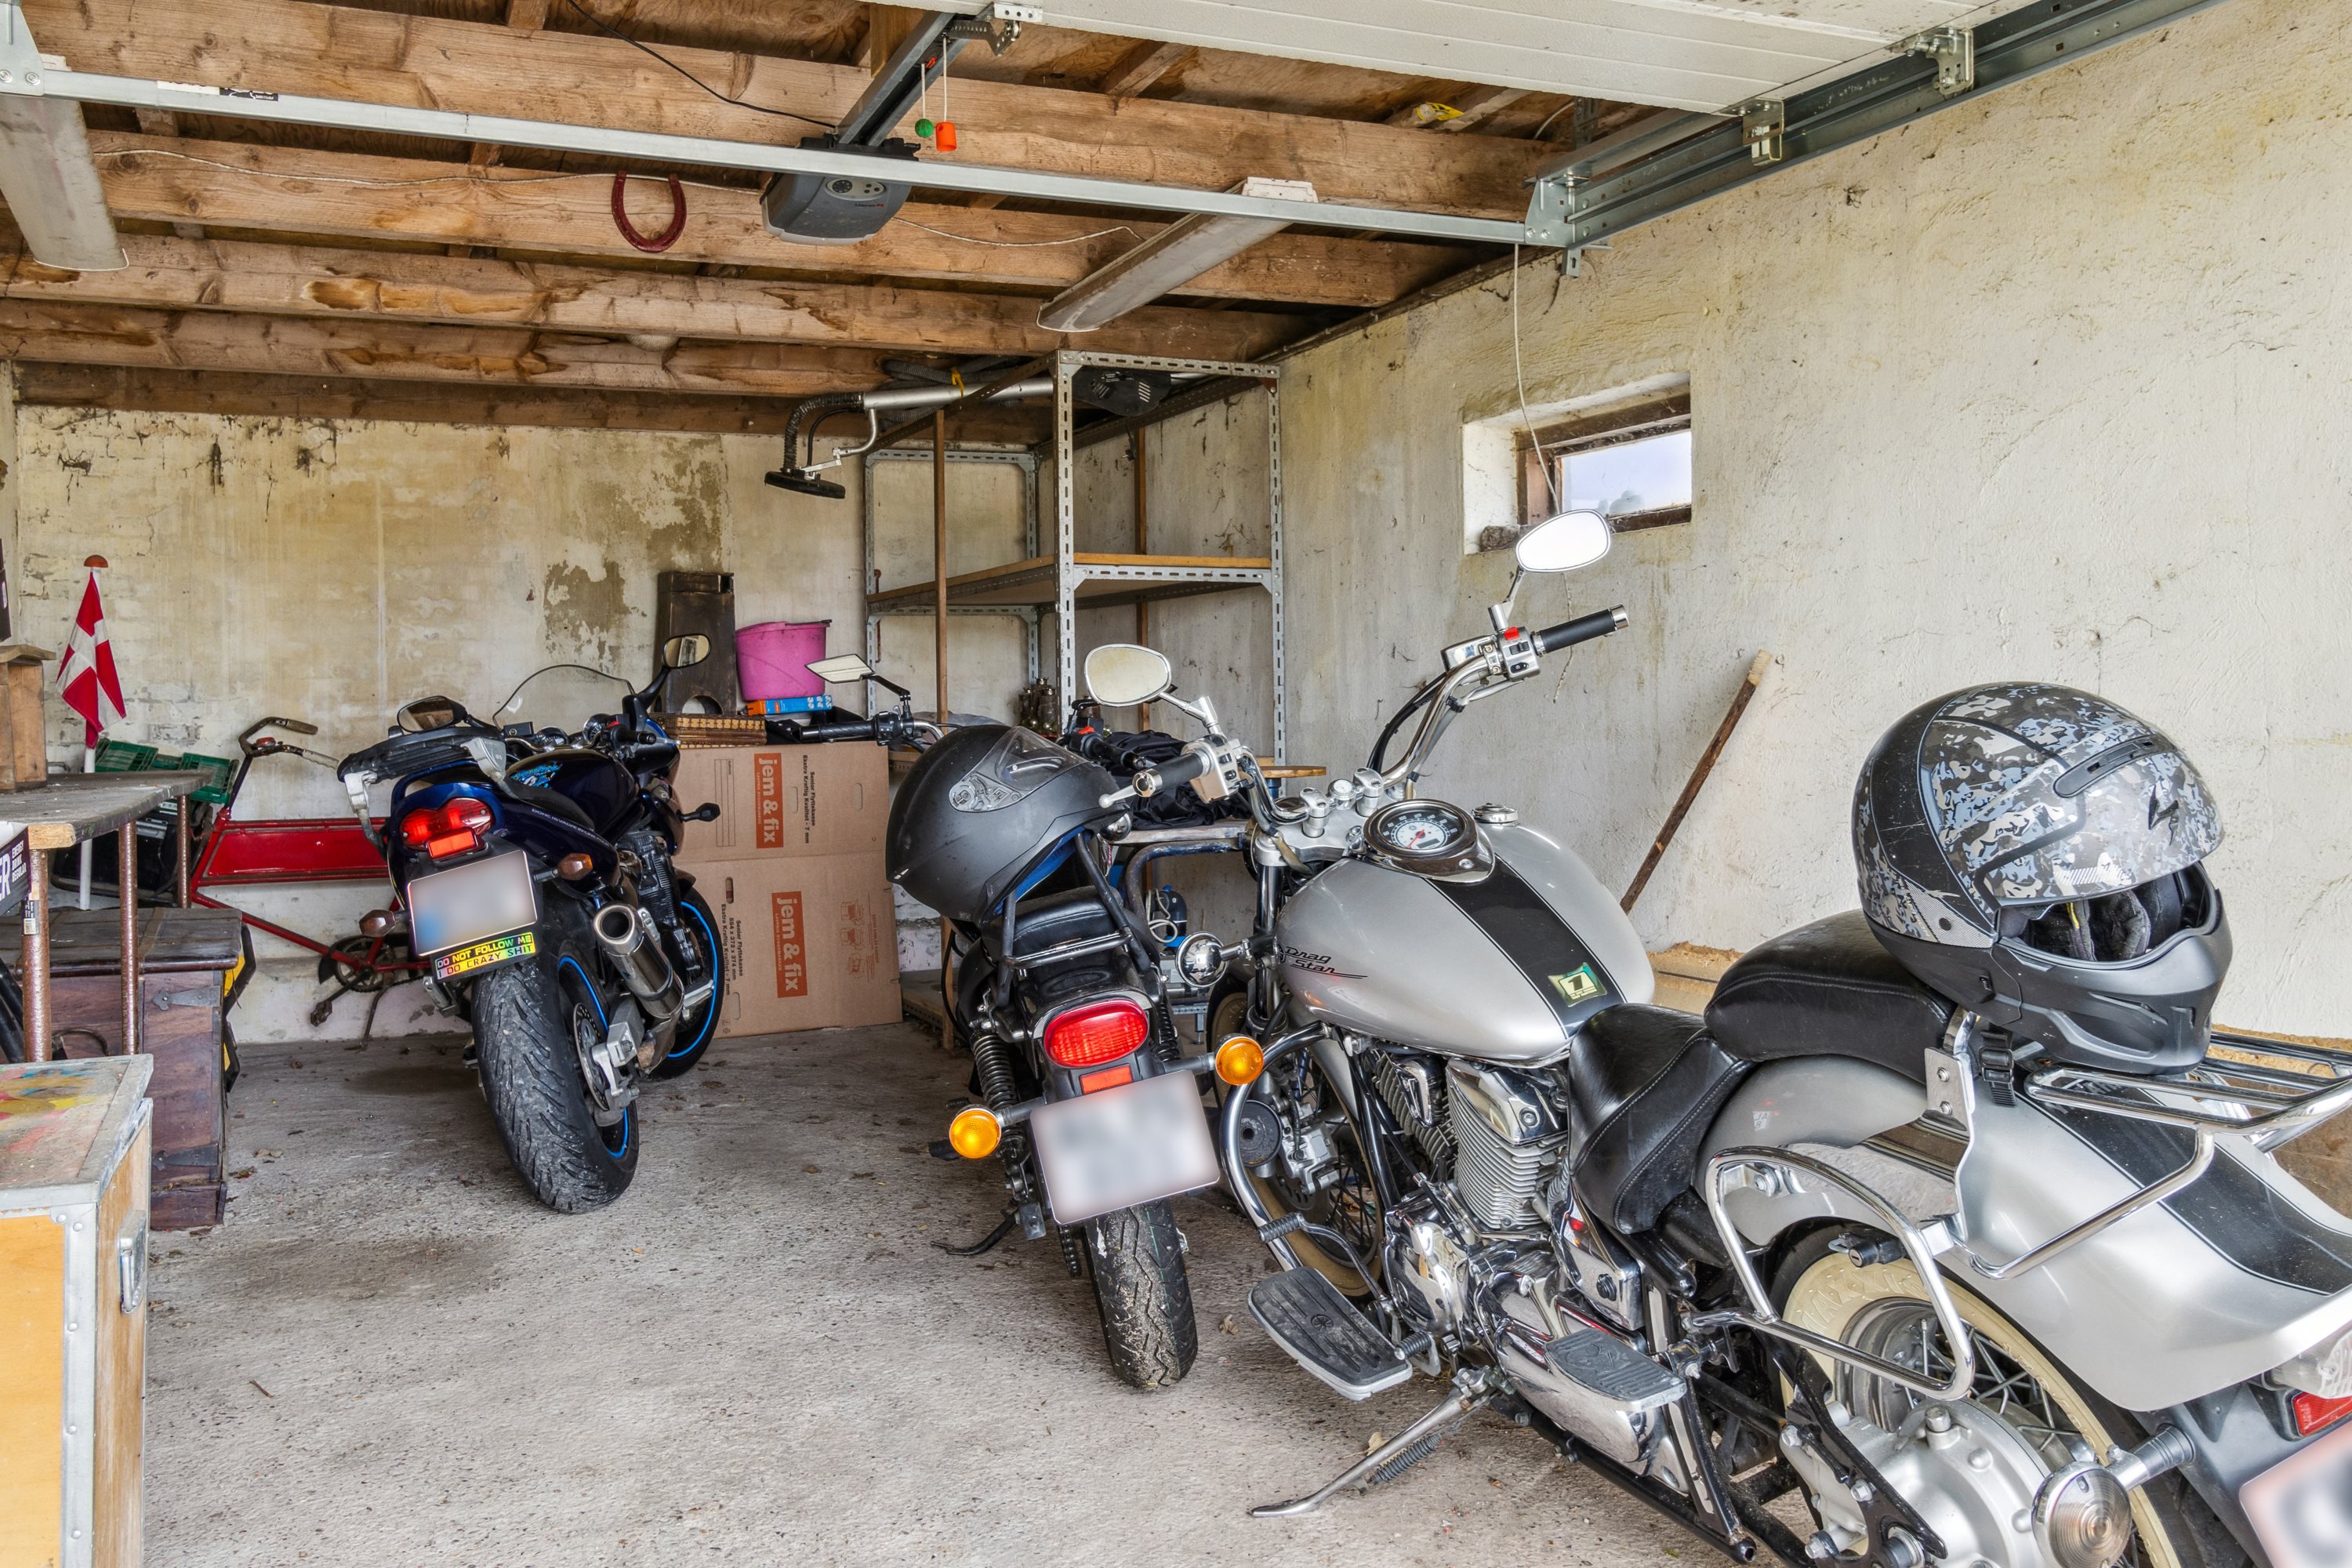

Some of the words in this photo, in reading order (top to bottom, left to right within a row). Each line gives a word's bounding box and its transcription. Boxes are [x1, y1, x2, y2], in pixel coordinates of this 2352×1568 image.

[758, 758, 778, 797] jem
[763, 799, 779, 815] &
[764, 817, 779, 843] fix
[804, 833, 809, 844] mm
[777, 898, 797, 939] jem
[437, 957, 449, 968] DO
[452, 950, 471, 963] NOT
[475, 938, 514, 956] FOLLOW
[517, 934, 532, 945] ME
[447, 964, 460, 975] DO
[466, 953, 501, 968] CRAZY
[507, 945, 532, 956] SHIT
[784, 943, 800, 960] &
[1285, 946, 1331, 964] Drag
[785, 962, 802, 992] fix
